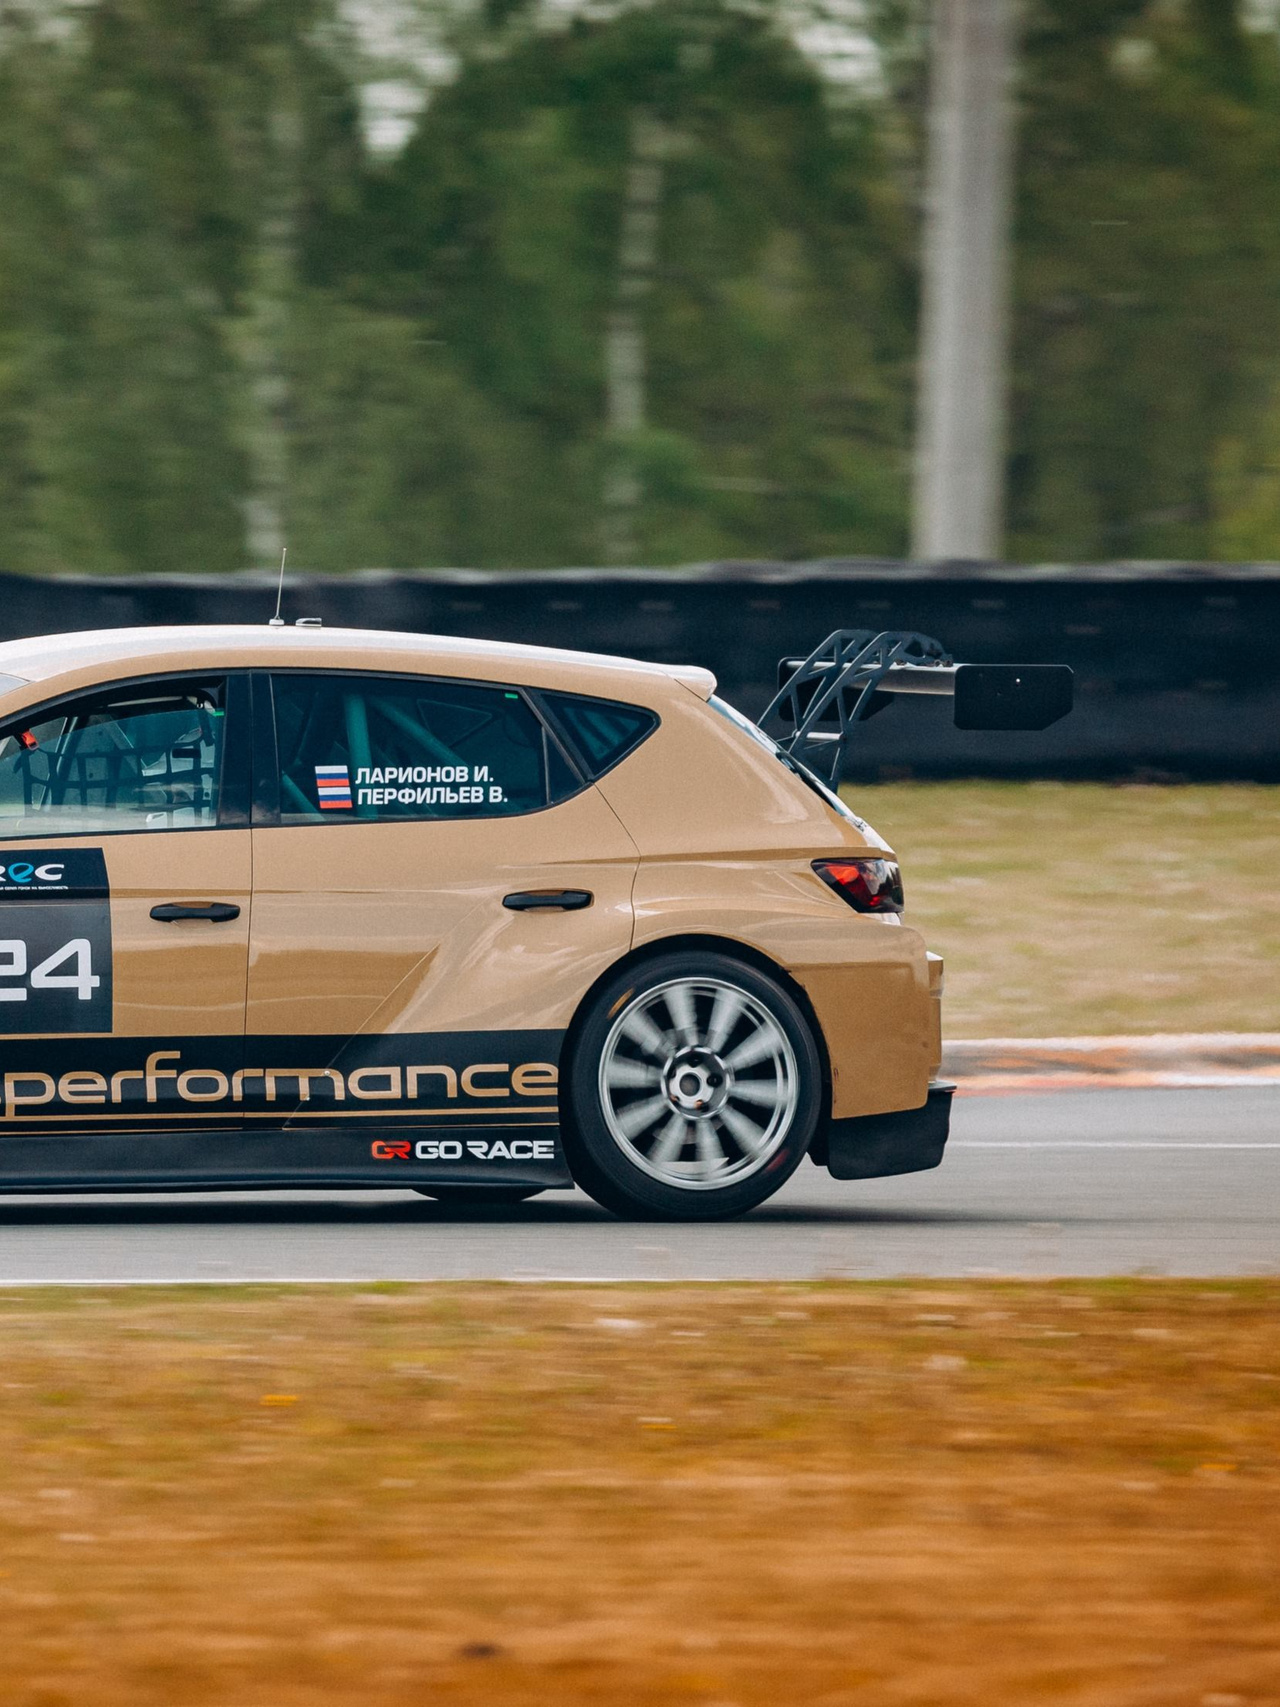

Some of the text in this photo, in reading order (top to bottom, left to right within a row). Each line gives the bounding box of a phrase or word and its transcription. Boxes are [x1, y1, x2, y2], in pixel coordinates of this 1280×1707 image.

[355, 765, 495, 785] ЛАРИОНОВ И.
[357, 785, 508, 805] ПЕРФИЛЬЕВ В.
[415, 1140, 463, 1160] GO
[466, 1140, 555, 1160] RACE
